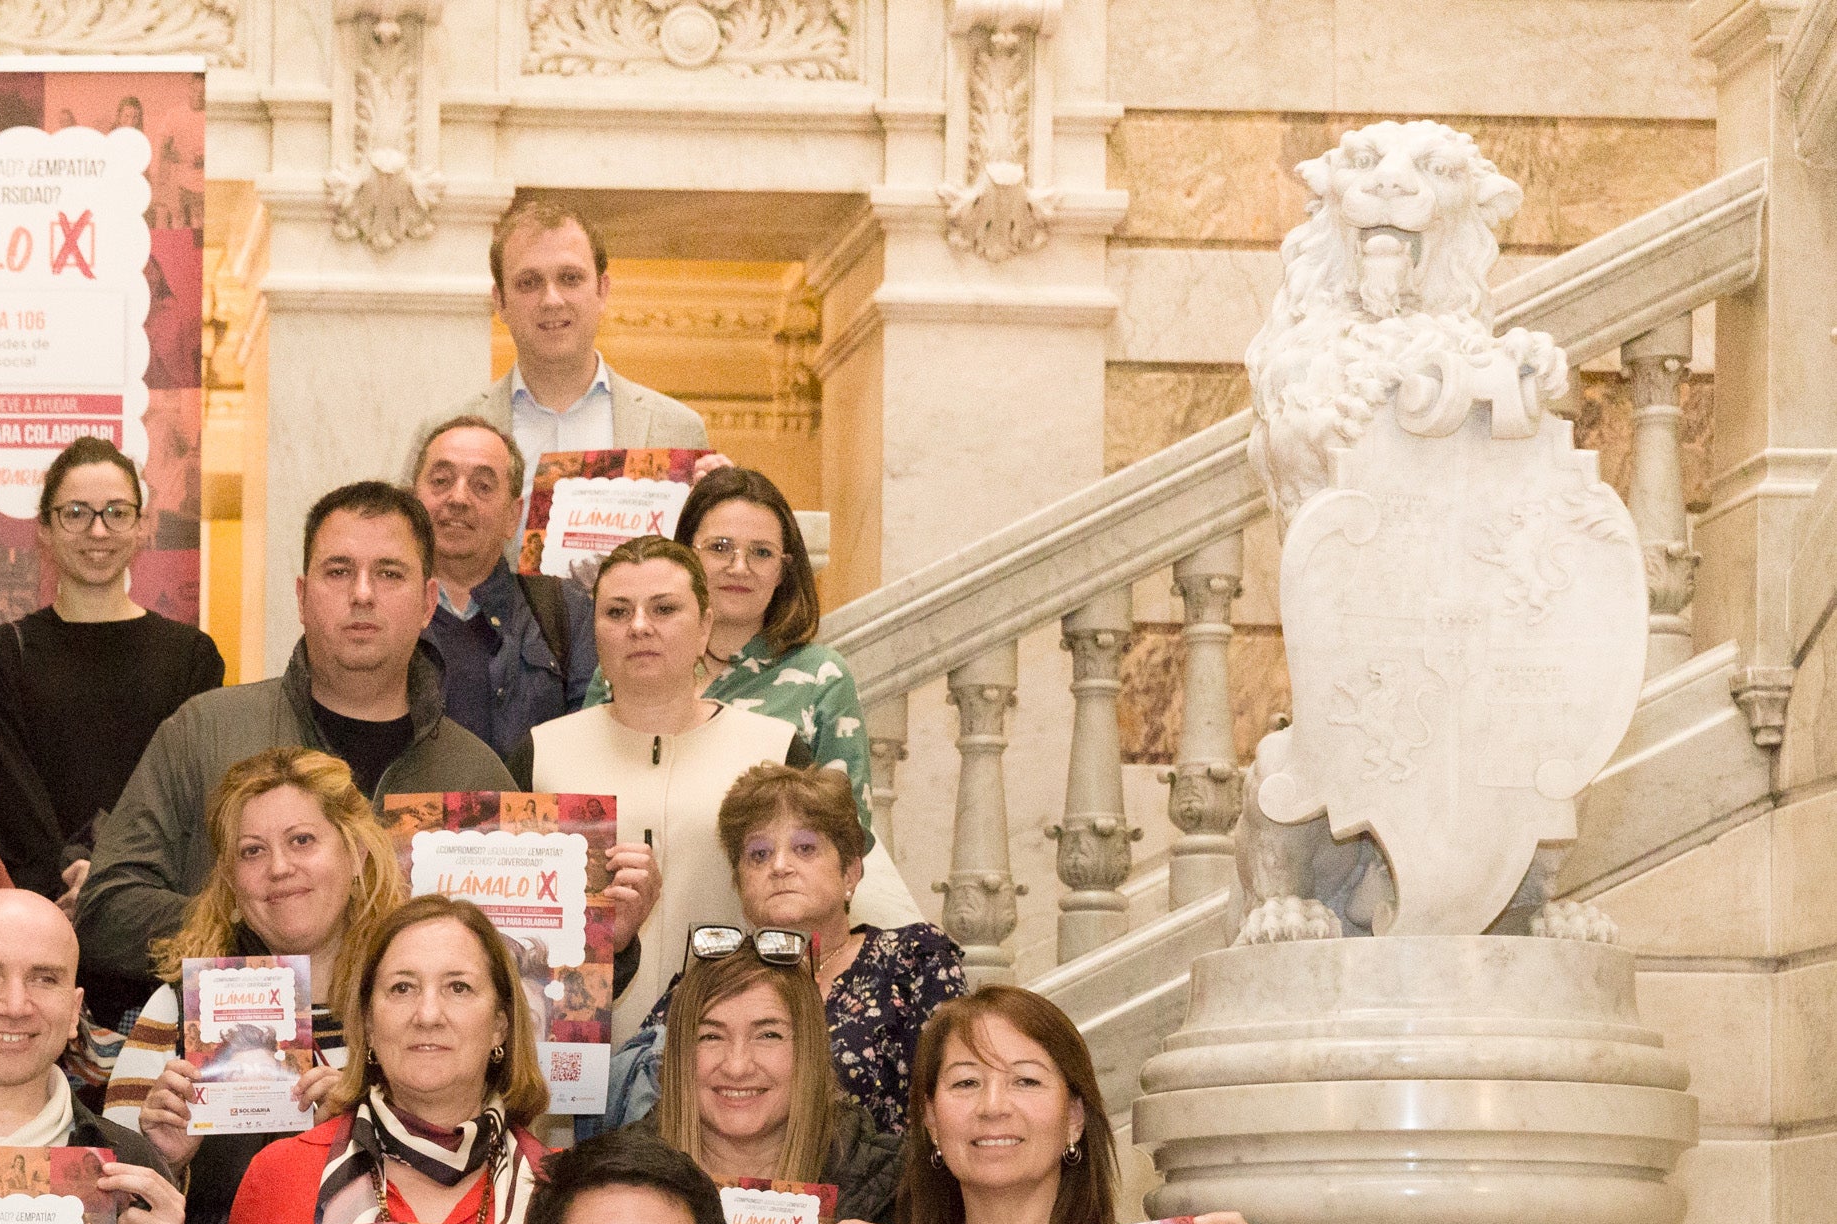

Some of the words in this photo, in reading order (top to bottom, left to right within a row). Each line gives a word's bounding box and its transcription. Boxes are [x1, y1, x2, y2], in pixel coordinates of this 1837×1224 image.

[28, 158, 106, 178] ¿EMPATÍA?
[16, 311, 45, 330] 106
[31, 338, 50, 350] de
[437, 870, 529, 899] LLÁMALO
[215, 990, 265, 1006] LLÁMALO
[16, 1211, 56, 1222] ¿EMPATÍA?
